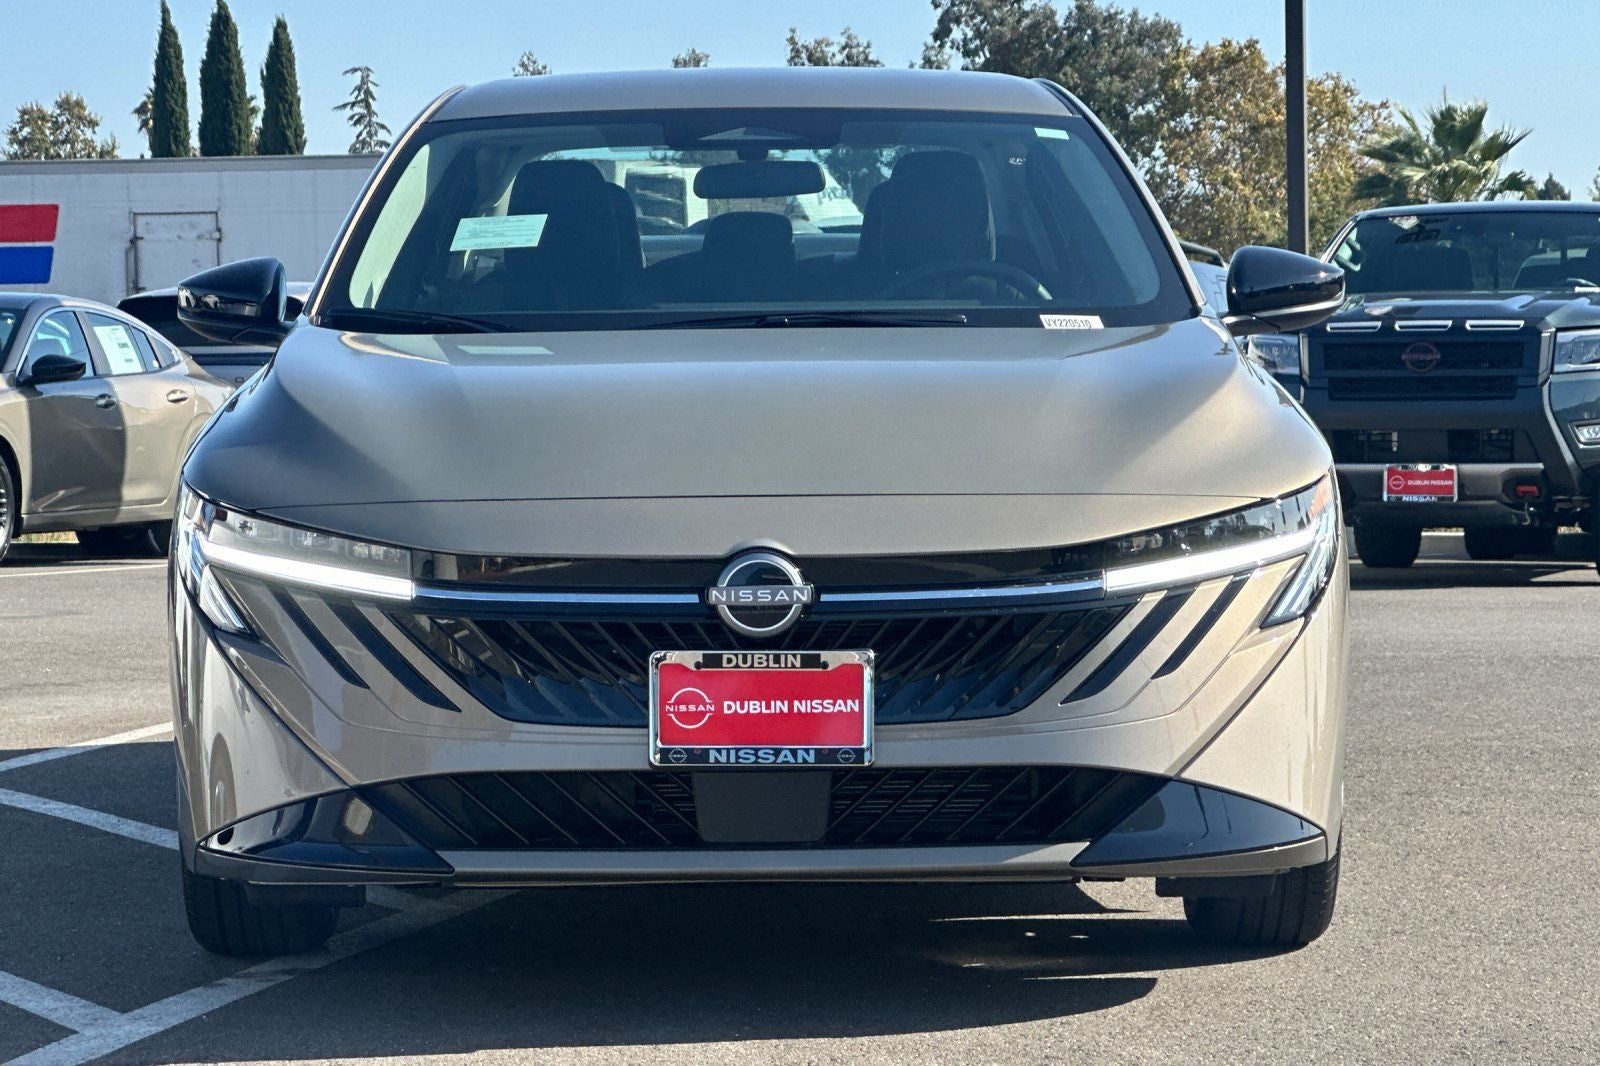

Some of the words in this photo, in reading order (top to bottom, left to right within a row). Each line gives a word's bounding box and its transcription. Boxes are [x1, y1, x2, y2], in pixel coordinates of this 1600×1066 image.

[711, 589, 808, 602] NISSAN
[722, 654, 801, 668] DUBLIN
[665, 704, 715, 712] NISSAN
[723, 700, 788, 714] DUBLIN
[793, 699, 859, 713] NISSAN
[709, 749, 815, 763] NISSAN
